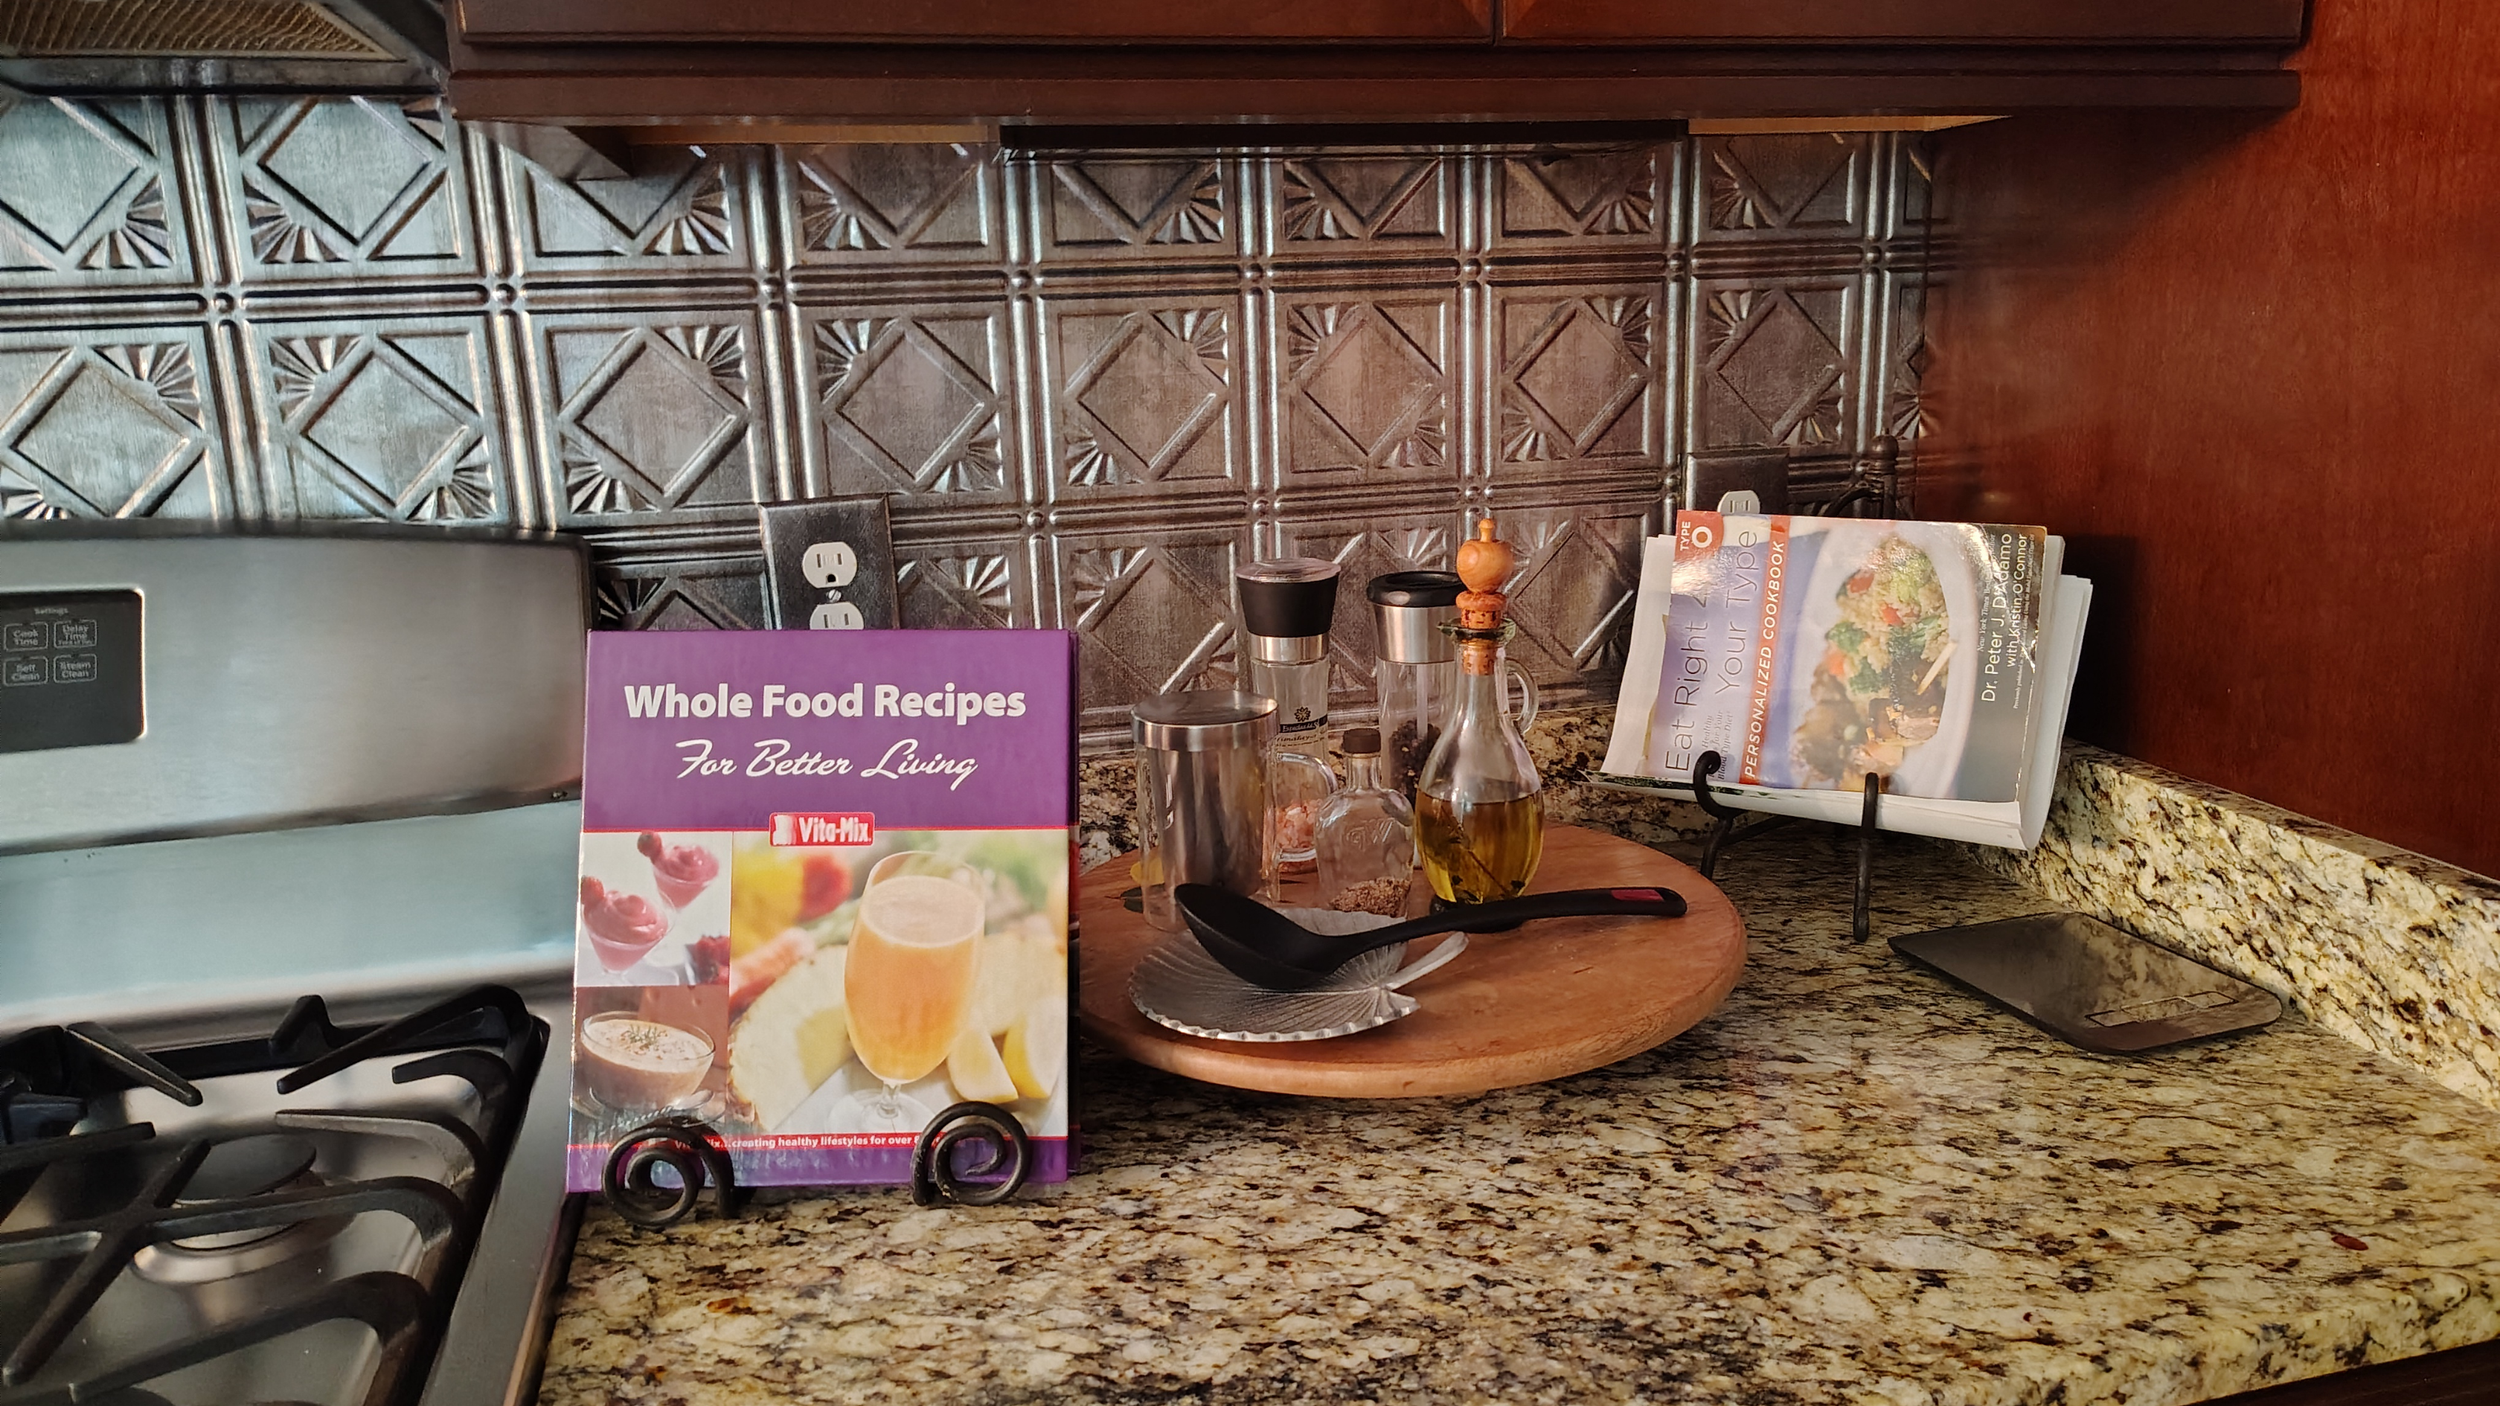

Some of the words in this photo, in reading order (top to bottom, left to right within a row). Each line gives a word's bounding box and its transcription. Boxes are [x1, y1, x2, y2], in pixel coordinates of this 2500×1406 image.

[1680, 521, 1691, 551] TYPE
[1691, 526, 1713, 548] O
[1726, 531, 1759, 608] Type
[1992, 533, 2012, 608] D'Adamo
[2012, 533, 2027, 594] O'Connor
[1981, 596, 1989, 616] Times
[2008, 597, 2022, 637] Kristin
[13, 629, 39, 639] Cook
[1979, 617, 1987, 634] York
[1991, 614, 2005, 627] J.
[15, 638, 38, 646] Time
[65, 632, 88, 641] Time
[1976, 637, 1985, 652] New
[1674, 621, 1708, 706] Right
[1715, 621, 1747, 694] Your
[1744, 646, 1772, 778] PERSONALIZED
[1762, 541, 1785, 639] COOKBOOK
[1984, 631, 2003, 674] Peter
[2006, 640, 2019, 667] with
[11, 672, 40, 681] Clean
[62, 670, 89, 679] Clean
[624, 683, 753, 718] Whole
[763, 682, 864, 718] Food
[874, 682, 1026, 726] Recipes
[1981, 680, 1998, 702] Dr.
[1665, 719, 1695, 771] Eat
[1702, 715, 1714, 748] Healthy
[1720, 733, 1731, 754] Type
[675, 738, 737, 779] For
[745, 738, 853, 777] Better
[860, 738, 979, 791] Living
[1717, 756, 1727, 780] Blood
[799, 816, 870, 843] Vita-Mix
[777, 1136, 819, 1148] healthy
[820, 1135, 868, 1147] lifestyles
[870, 1135, 887, 1145] for
[888, 1136, 913, 1145] over
